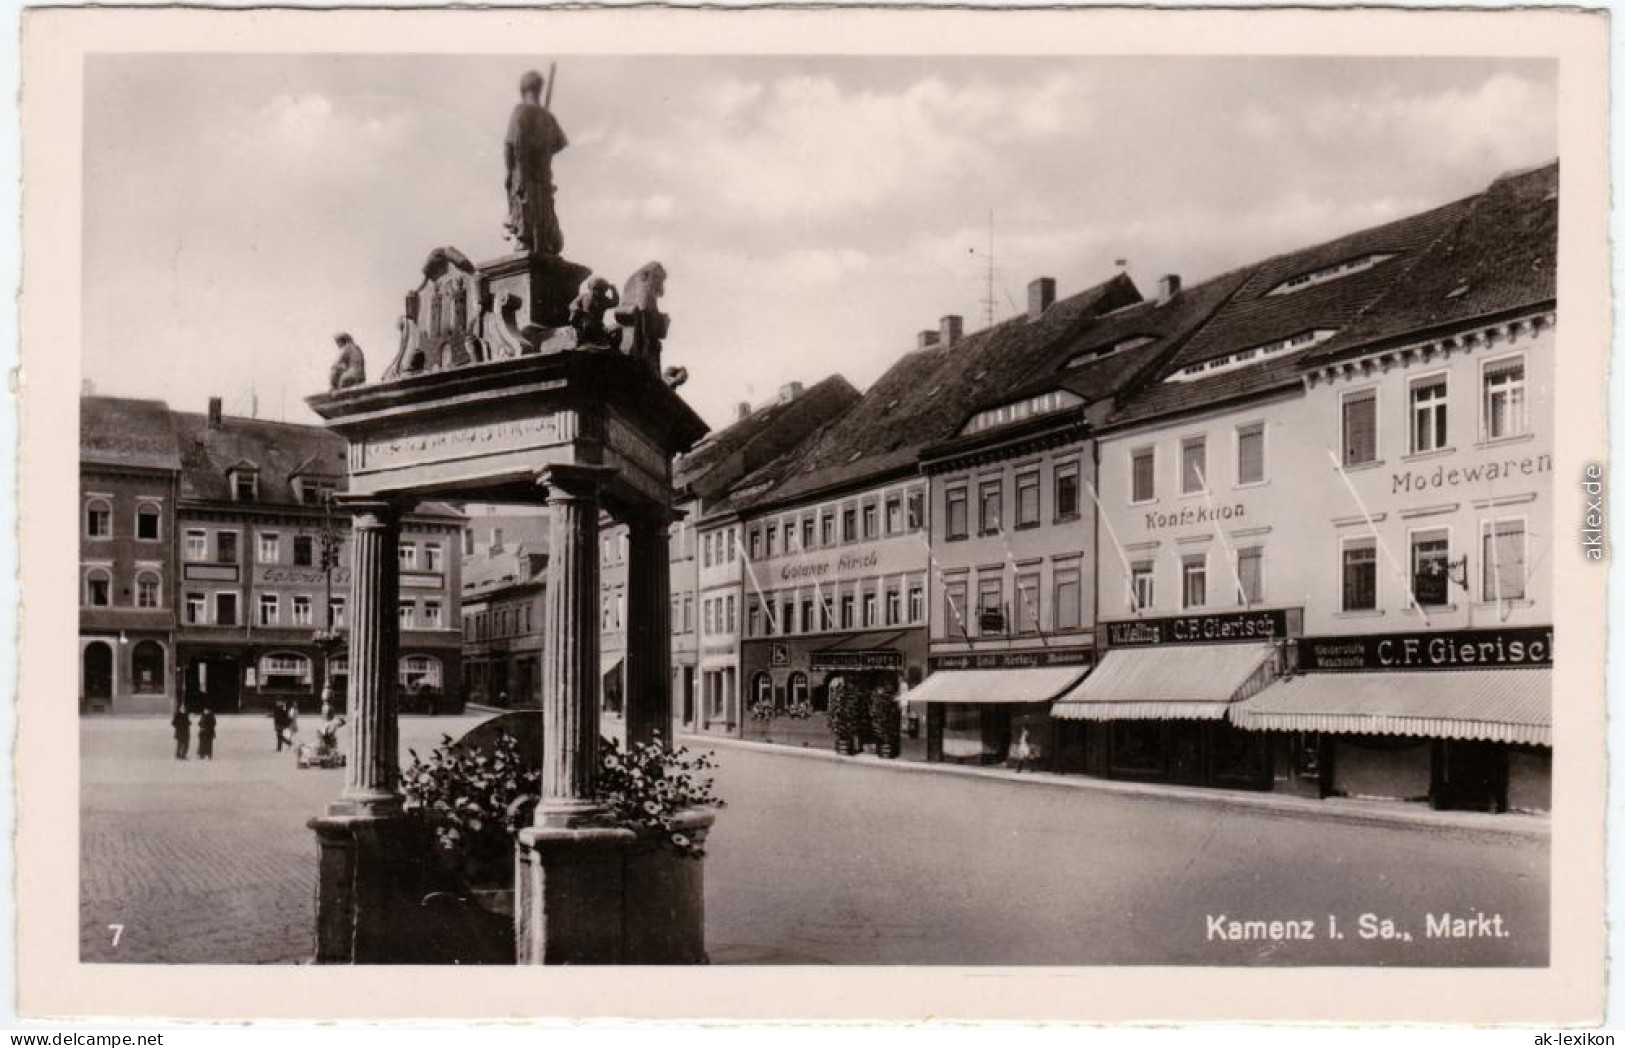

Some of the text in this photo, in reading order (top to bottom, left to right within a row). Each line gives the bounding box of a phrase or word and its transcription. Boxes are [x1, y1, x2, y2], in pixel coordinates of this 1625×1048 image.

[1392, 454, 1553, 494] Modewaren
[1145, 504, 1244, 529] Konfektion
[1203, 613, 1275, 638] Gierisch
